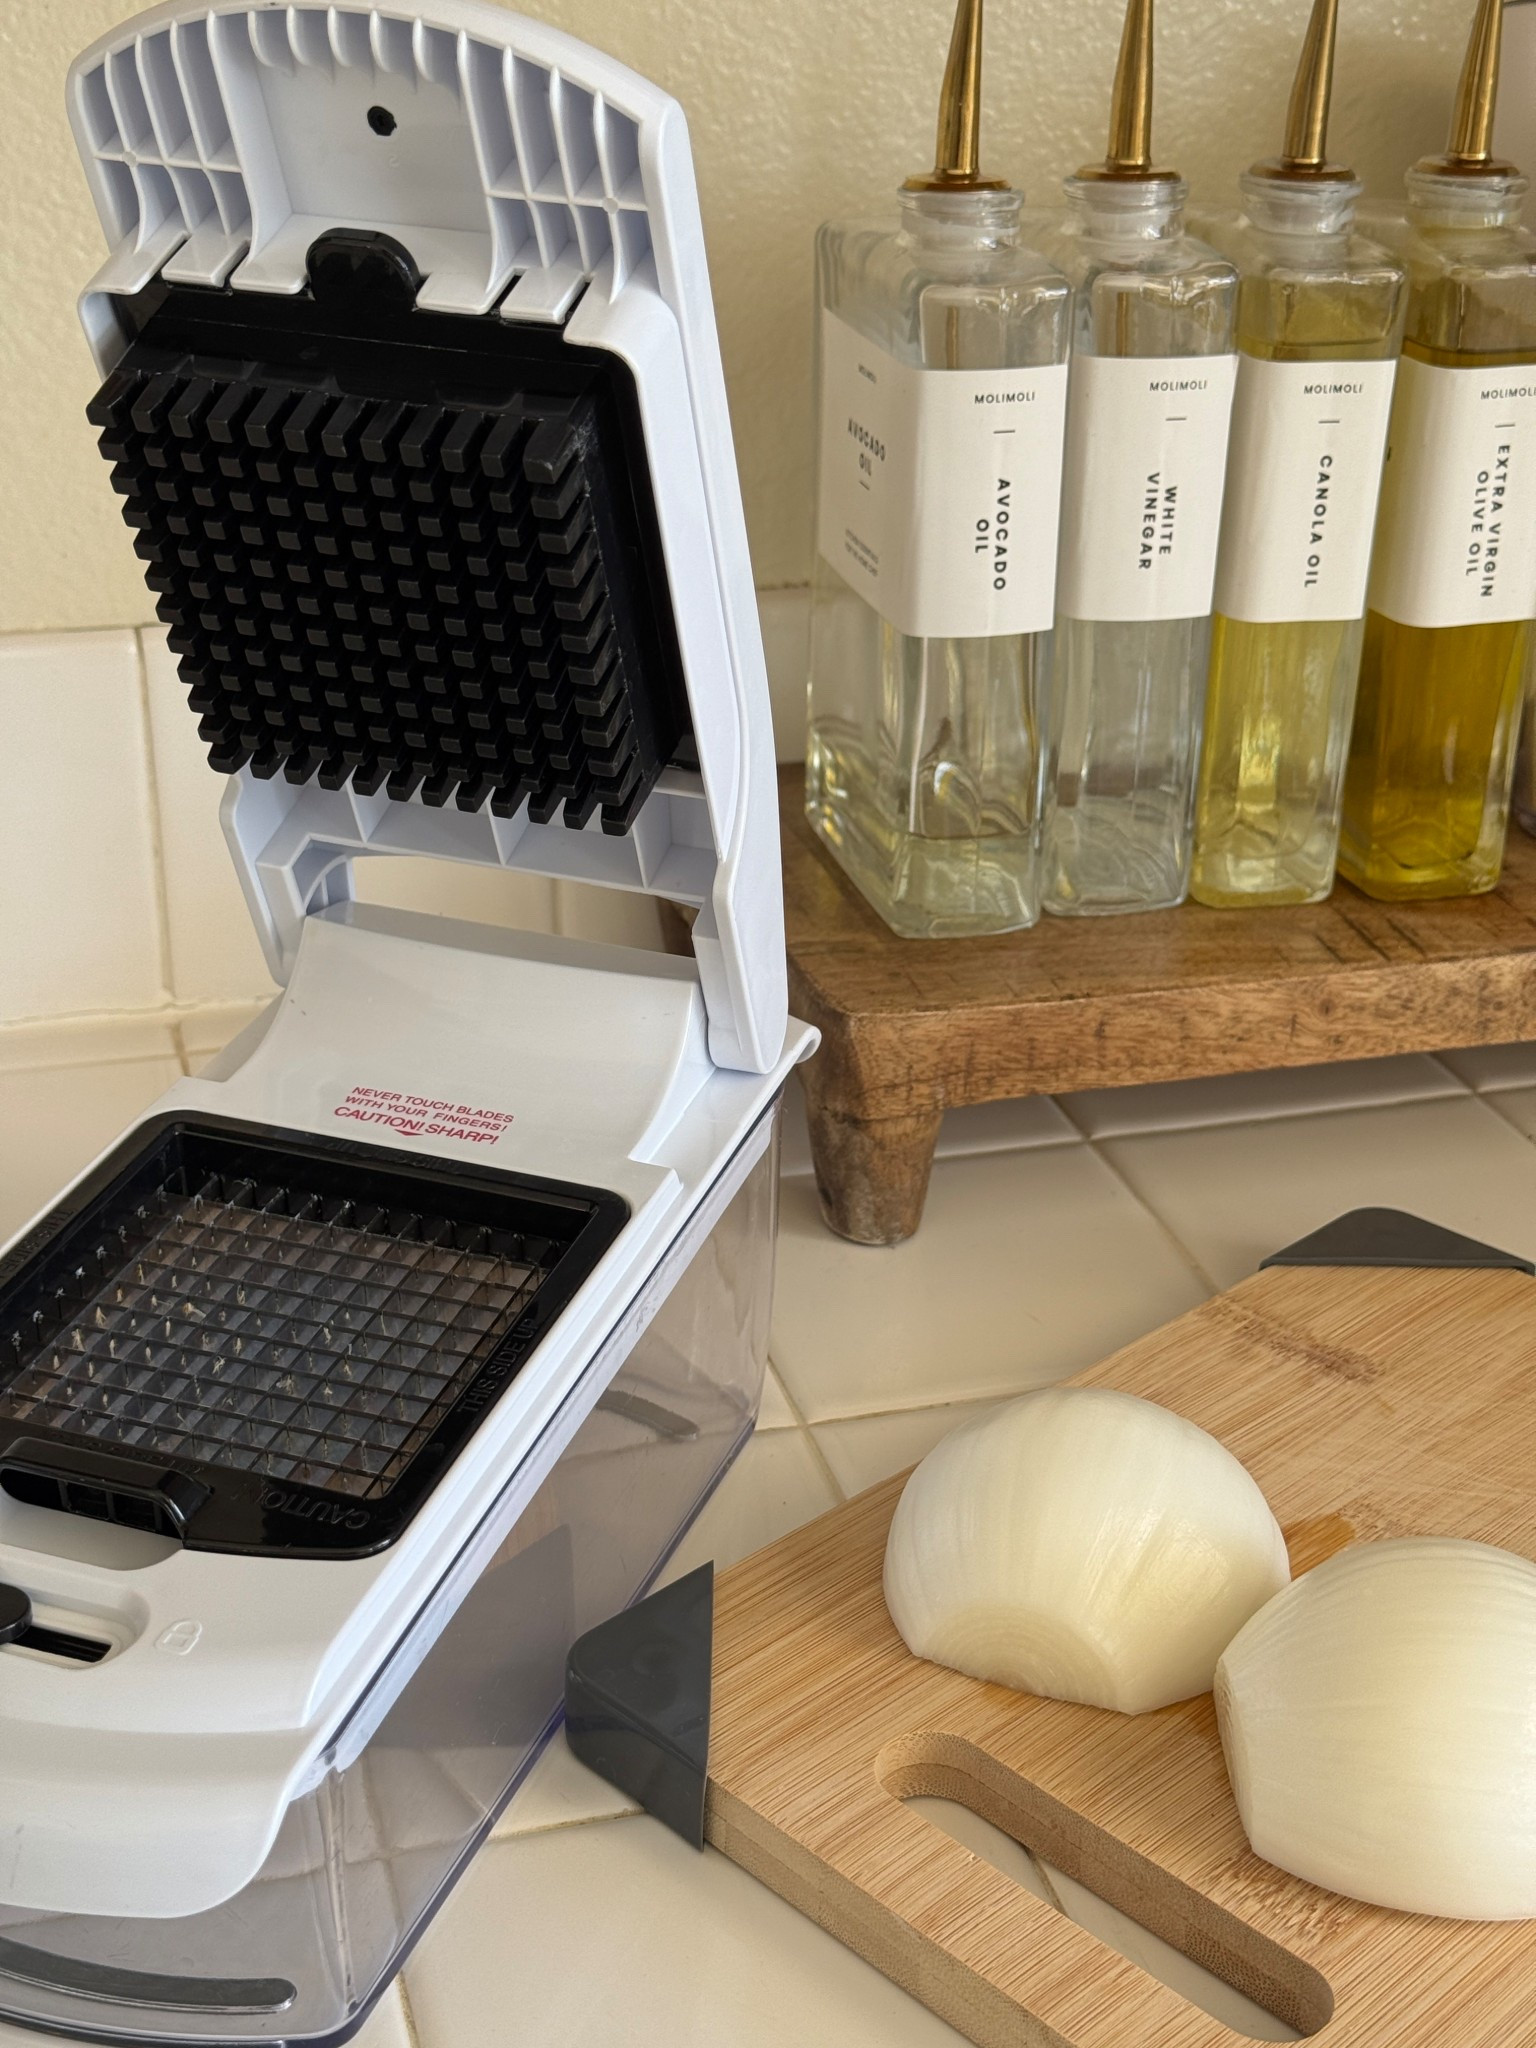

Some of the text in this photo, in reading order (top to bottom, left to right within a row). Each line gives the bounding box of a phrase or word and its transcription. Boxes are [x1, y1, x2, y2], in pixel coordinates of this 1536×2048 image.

[974, 391, 1035, 404] MOLIMOLI
[1149, 380, 1207, 392] MOLIMOLI
[1303, 383, 1363, 395] MOLIMOLI
[847, 417, 886, 462] AVOCADO
[975, 518, 990, 554] OIL
[993, 478, 1011, 591] AVOCADO
[1138, 472, 1160, 570] VINEGAR
[1158, 485, 1178, 555] WHITE
[1304, 455, 1333, 588] CANOLA OIL
[1465, 470, 1490, 576] OLIVE OIL
[1480, 444, 1511, 597] EXTRA VIRGIN
[334, 1106, 499, 1145] CAUTION! SHARP!
[345, 1096, 507, 1132] WITH YOUR FINGERS!
[352, 1087, 515, 1123] NEVER TOUCH BLADES
[456, 1318, 539, 1412] THIS SIDE UP
